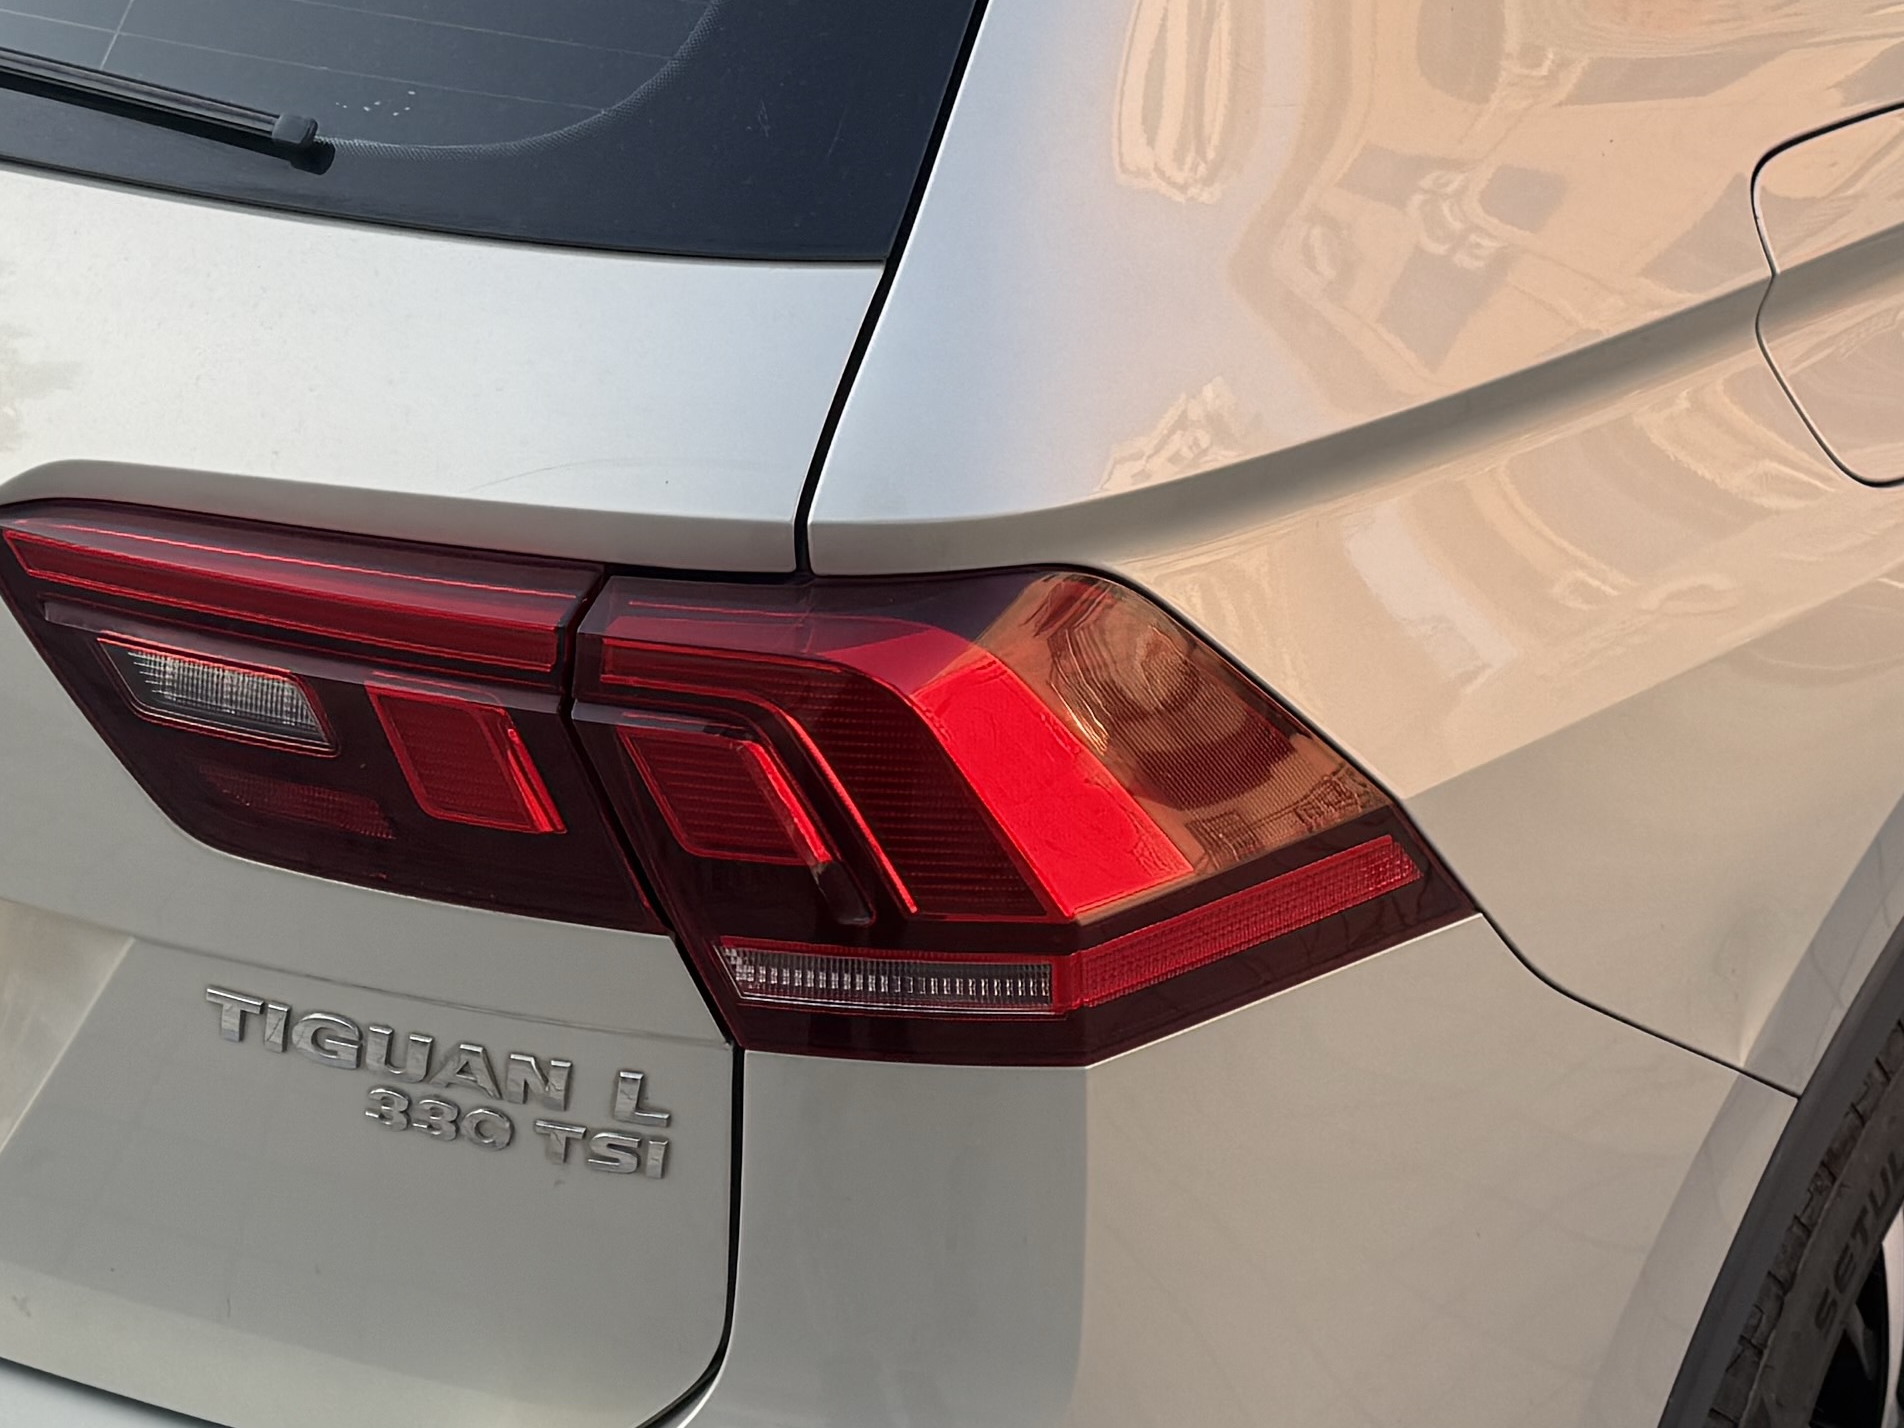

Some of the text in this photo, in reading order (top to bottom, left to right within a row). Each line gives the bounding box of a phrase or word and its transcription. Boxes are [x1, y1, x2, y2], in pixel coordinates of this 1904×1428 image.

[205, 983, 671, 1128] TIGUAN L
[364, 1085, 670, 1180] 330 TSI
